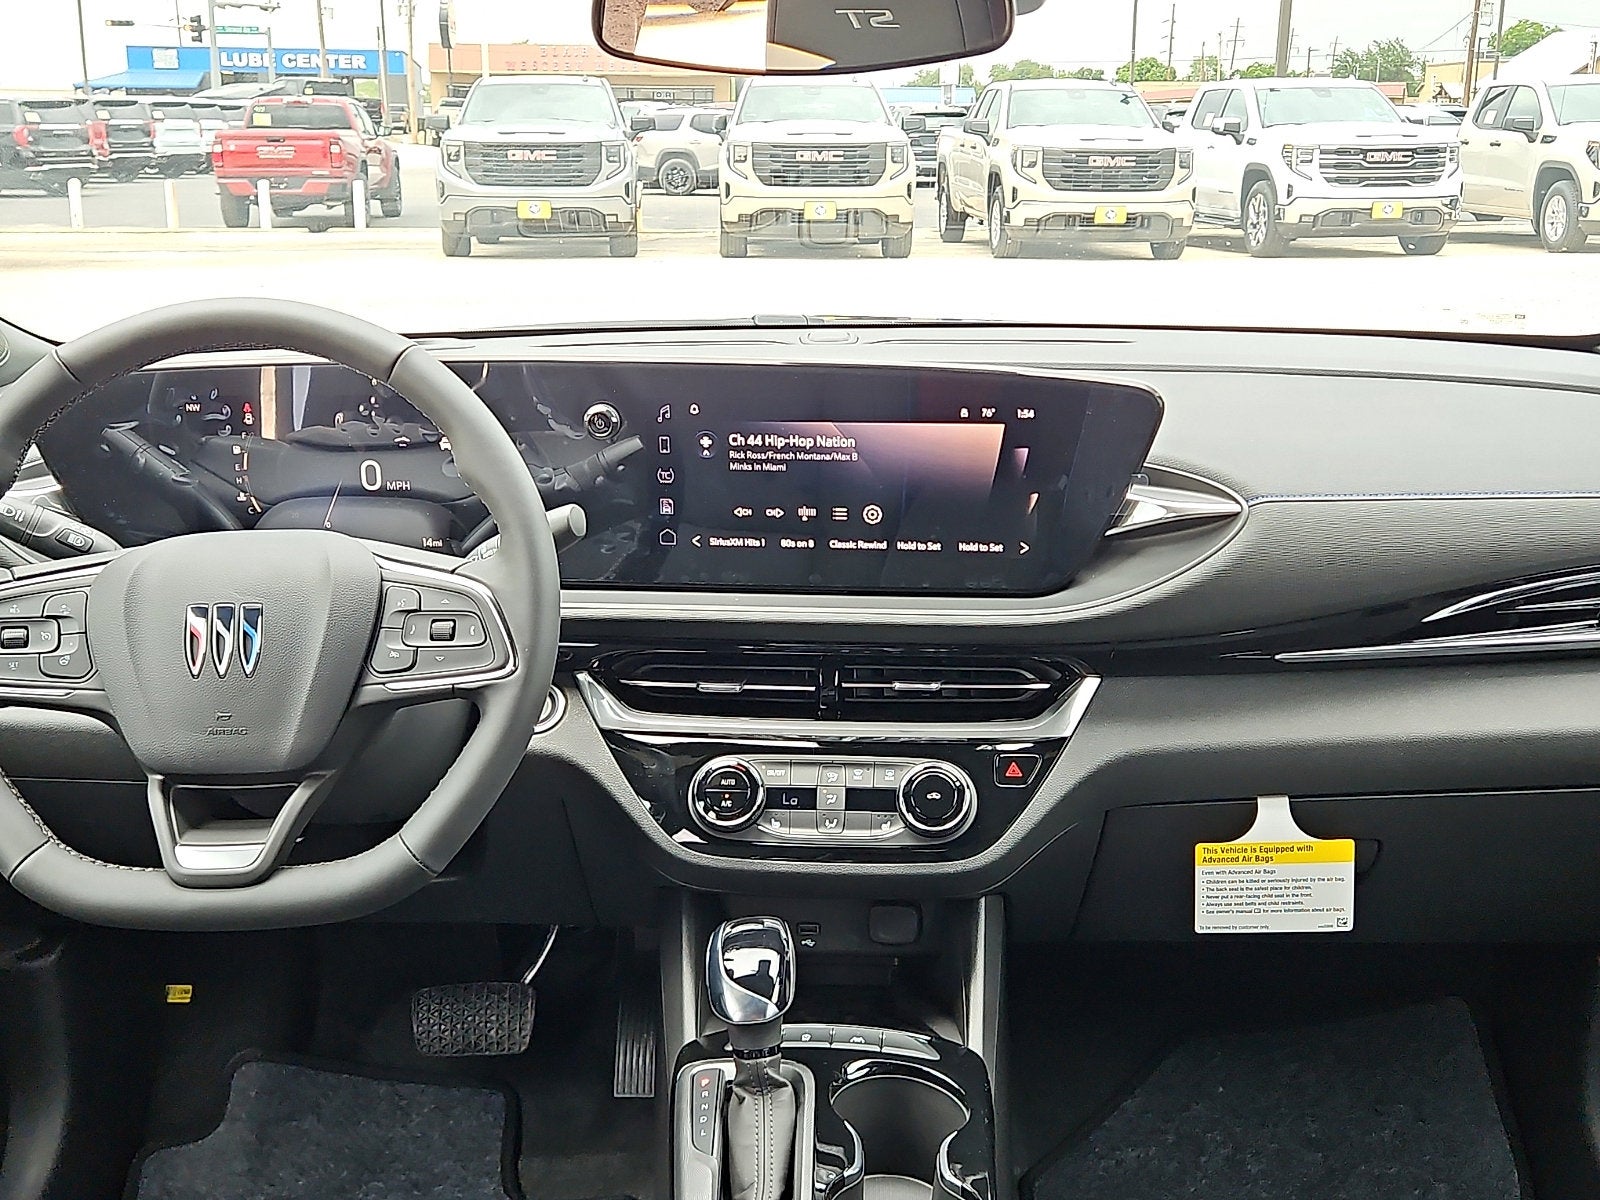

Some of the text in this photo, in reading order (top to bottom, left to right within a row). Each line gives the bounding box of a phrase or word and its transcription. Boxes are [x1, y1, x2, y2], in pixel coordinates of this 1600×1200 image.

[220, 52, 366, 70] LUBE CENTER
[506, 150, 557, 160] GMC
[796, 150, 844, 162] GMC
[1366, 152, 1413, 162] GMC
[1088, 156, 1136, 166] GMC
[185, 403, 201, 412] NW
[728, 434, 856, 449] Ch 44 Hip-Hop Nation
[729, 451, 745, 459] Rick
[746, 452, 795, 460] Ross/French
[797, 452, 850, 461] Montana/Max
[730, 462, 752, 471] Minks
[763, 463, 786, 471] Miami
[359, 460, 410, 491] 0 MPH
[710, 537, 744, 547] SiriusXM
[745, 538, 760, 547] Hits
[829, 540, 887, 549] Classic Rewind
[897, 541, 916, 550] Hold
[927, 542, 942, 551] Set
[958, 542, 978, 552] Hold
[989, 543, 1004, 552] Set
[206, 727, 248, 736] AIRBAG
[1259, 845, 1294, 854] Equipped
[1202, 855, 1239, 863] Advanced
[1255, 855, 1274, 863] Bags
[700, 1077, 710, 1088] P
